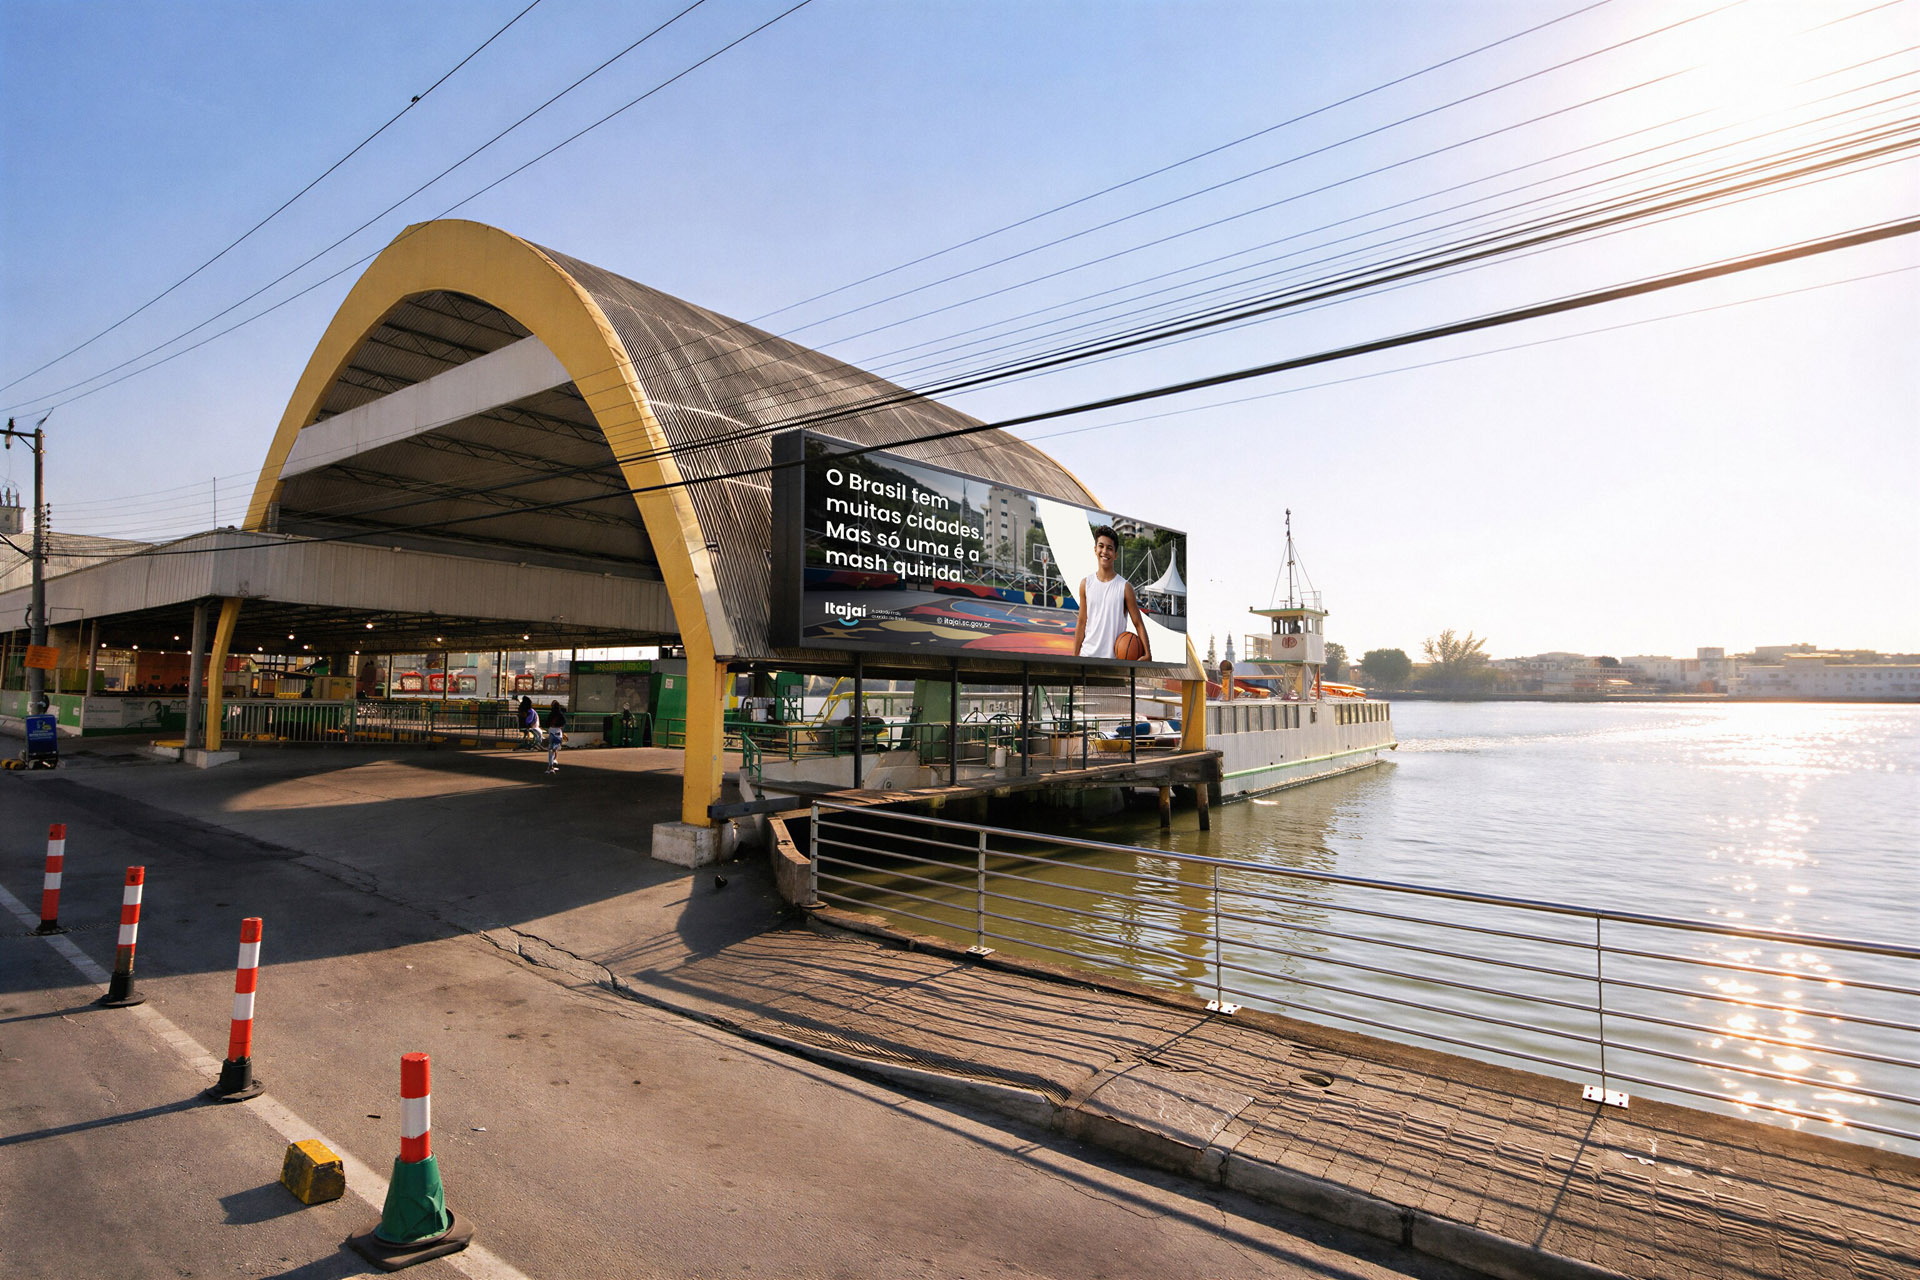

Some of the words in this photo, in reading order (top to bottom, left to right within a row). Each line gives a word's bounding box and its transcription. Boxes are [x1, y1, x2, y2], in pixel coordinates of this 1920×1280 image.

[826, 468, 844, 486] O
[849, 473, 906, 501] Brasil
[912, 487, 949, 510] tem
[826, 497, 901, 524] muitas
[906, 511, 984, 541] cidades.
[826, 520, 871, 544] Mas
[877, 531, 900, 549] só
[906, 538, 949, 557] uma
[953, 543, 965, 559] é
[968, 549, 980, 562] a
[826, 549, 888, 572] mash
[893, 560, 966, 583] quirida.
[825, 601, 867, 620] Itajaí
